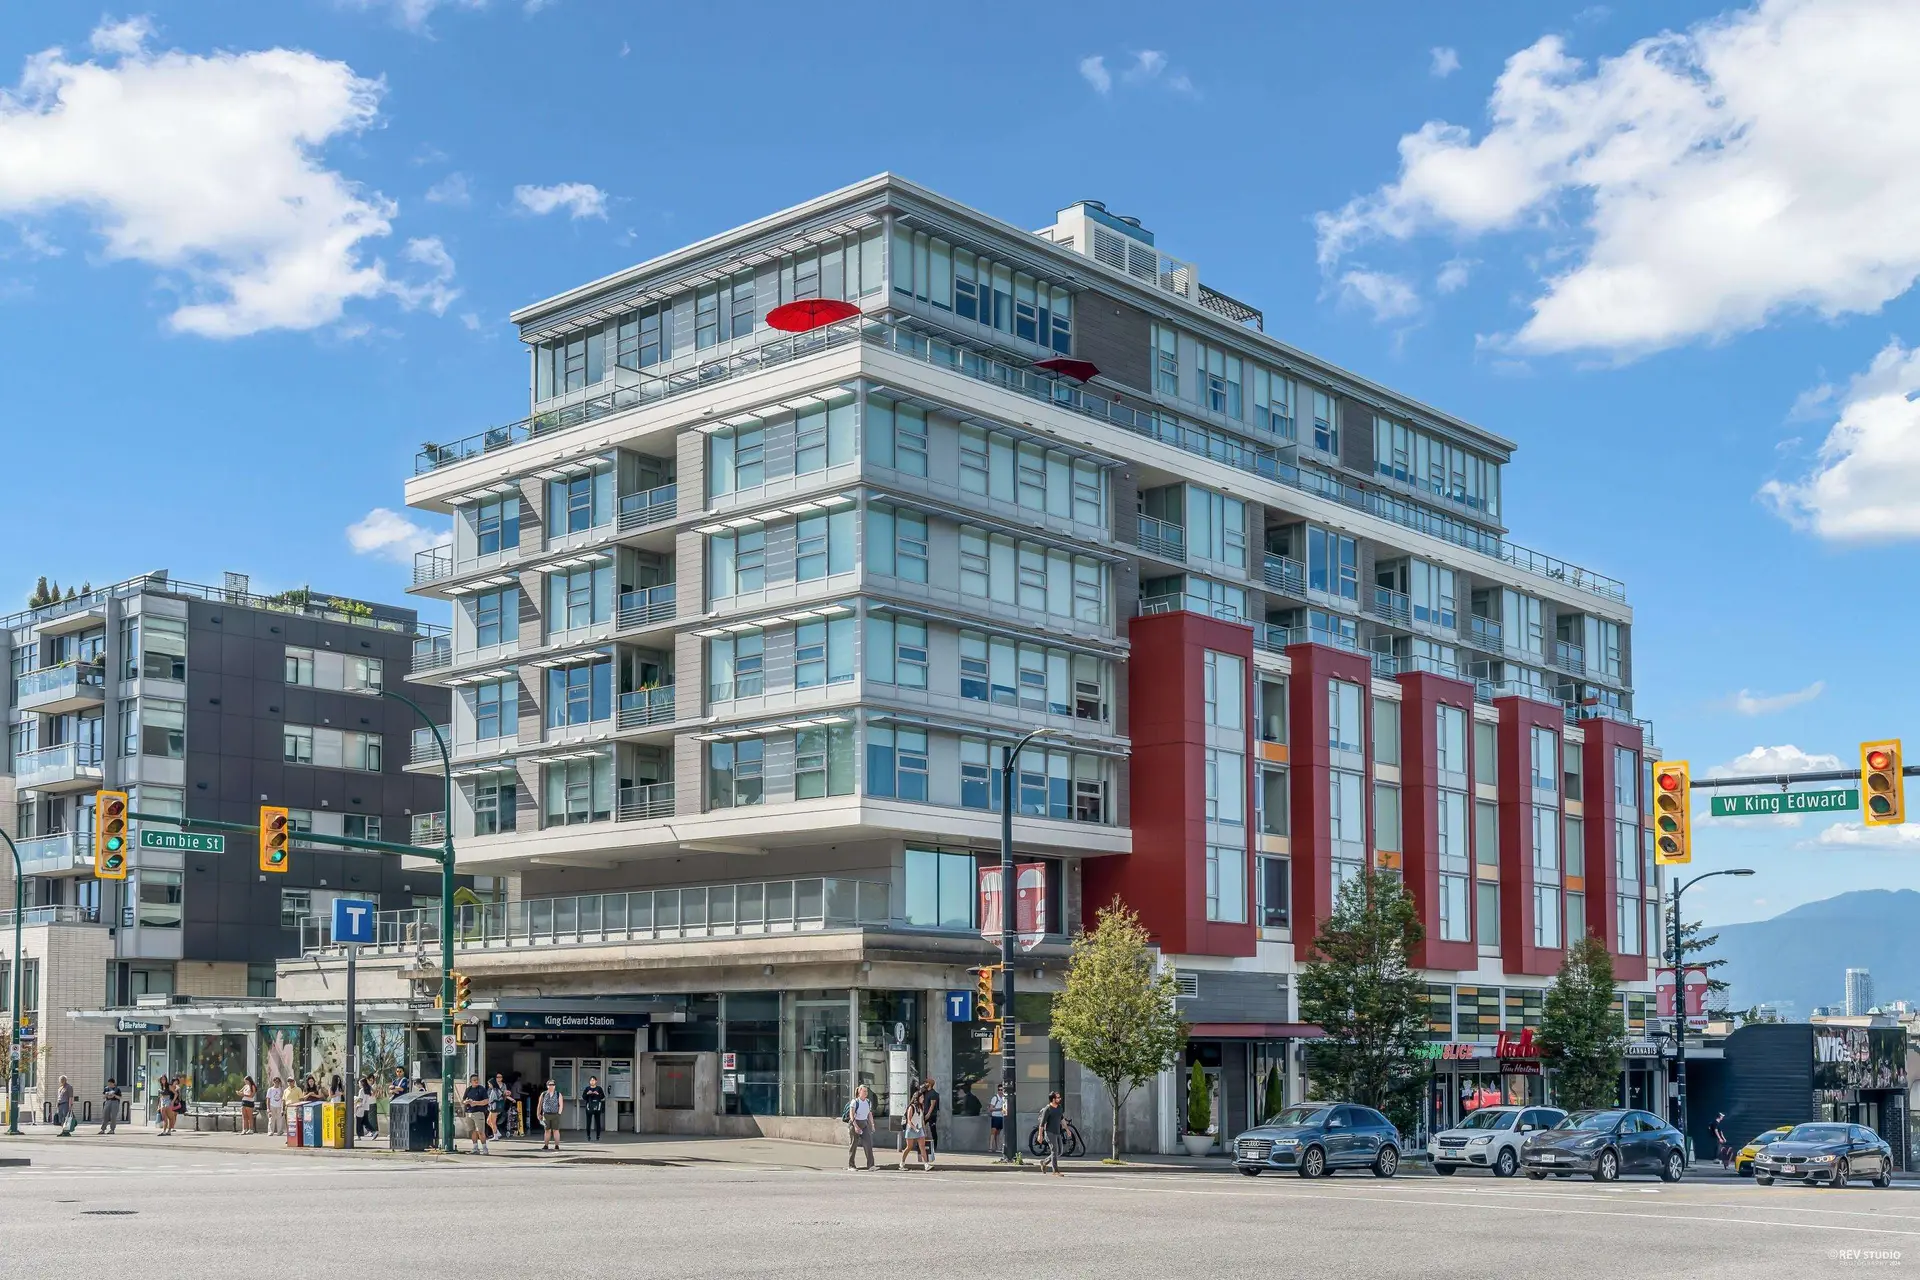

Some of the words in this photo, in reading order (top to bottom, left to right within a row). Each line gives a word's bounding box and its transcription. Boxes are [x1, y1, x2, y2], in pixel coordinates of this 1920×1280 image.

[1723, 797, 1737, 811] W
[1745, 796, 1780, 813] King
[1788, 791, 1847, 809] Edward
[147, 833, 199, 848] Cambie
[206, 837, 219, 850] St
[346, 906, 367, 935] T
[950, 996, 964, 1017] T
[495, 1014, 503, 1025] T
[544, 1015, 561, 1027] King
[562, 1015, 589, 1026] Edward
[589, 1016, 615, 1026] Station
[1628, 1046, 1657, 1055] CANNABIS
[1501, 1063, 1514, 1073] Tim
[1513, 1063, 1539, 1073] Hortons
